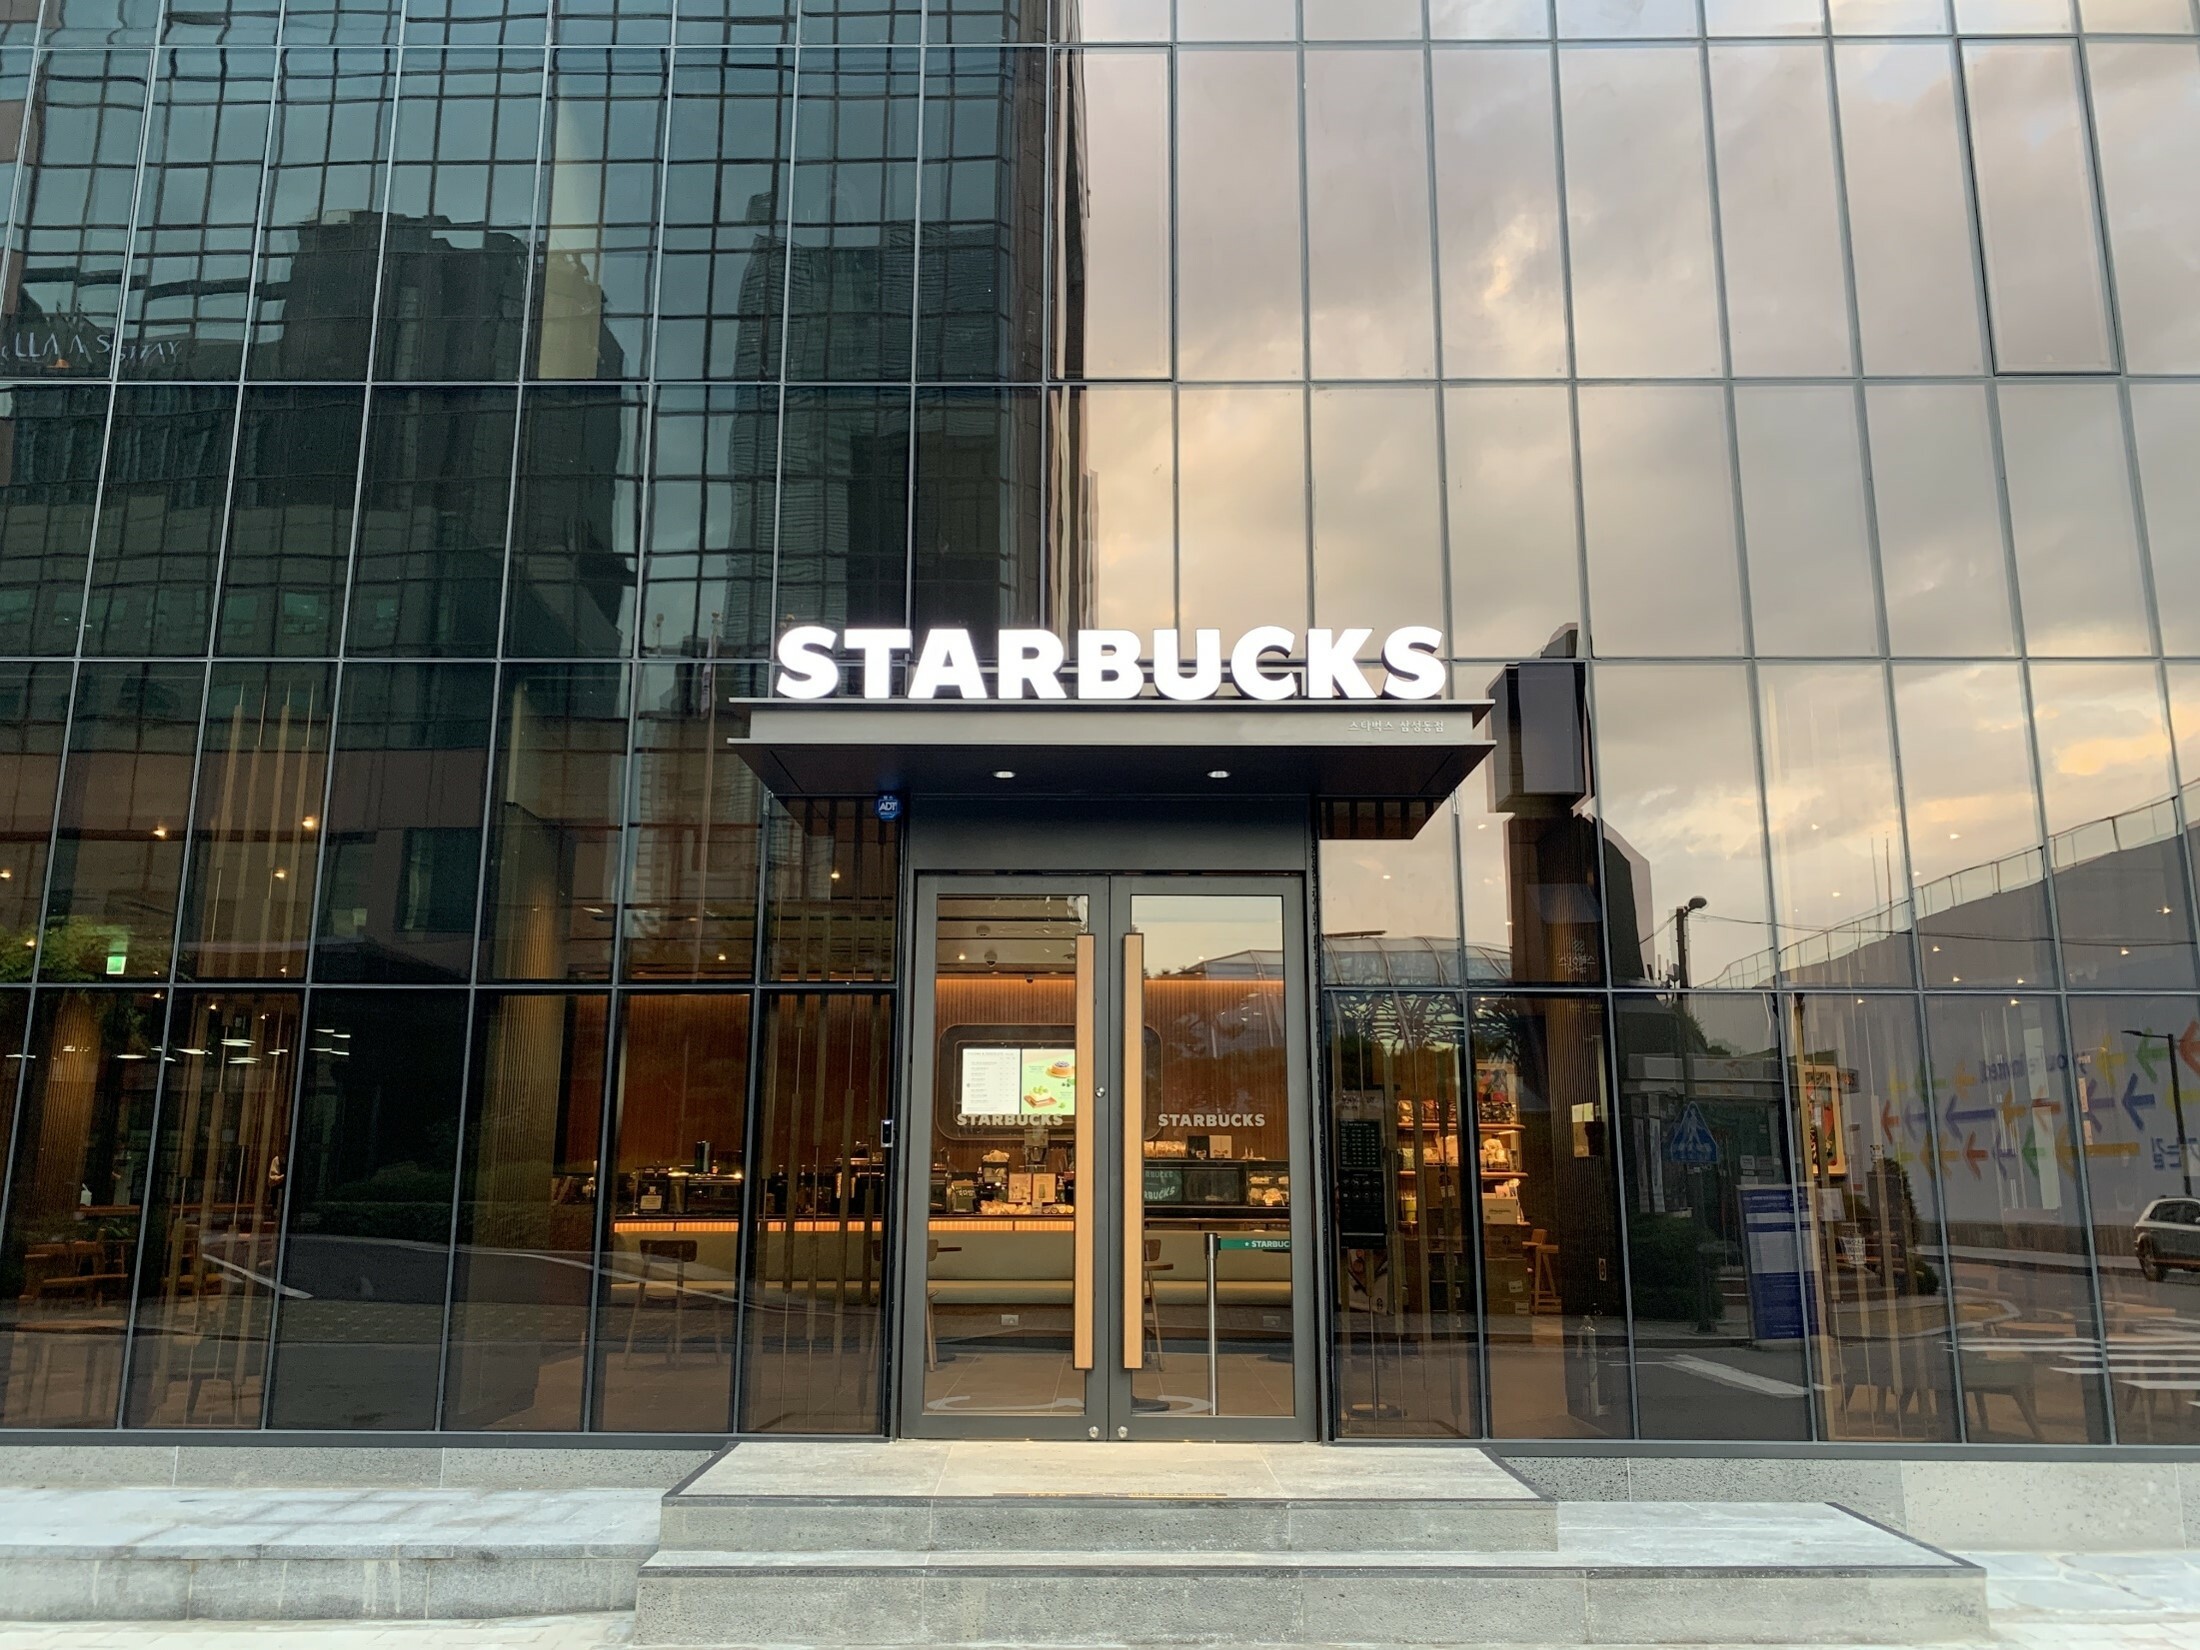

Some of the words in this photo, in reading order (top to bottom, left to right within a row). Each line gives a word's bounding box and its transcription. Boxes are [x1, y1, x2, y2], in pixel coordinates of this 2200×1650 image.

[776, 625, 1446, 701] STARBUCKS
[1347, 719, 1394, 732] 스타벅스
[1399, 719, 1444, 733] 삼성동점
[878, 801, 897, 811] ADT
[957, 1113, 1064, 1127] STARBUCKS
[1157, 1113, 1266, 1128] STARBUCKS
[1251, 1240, 1290, 1248] STARBUC
